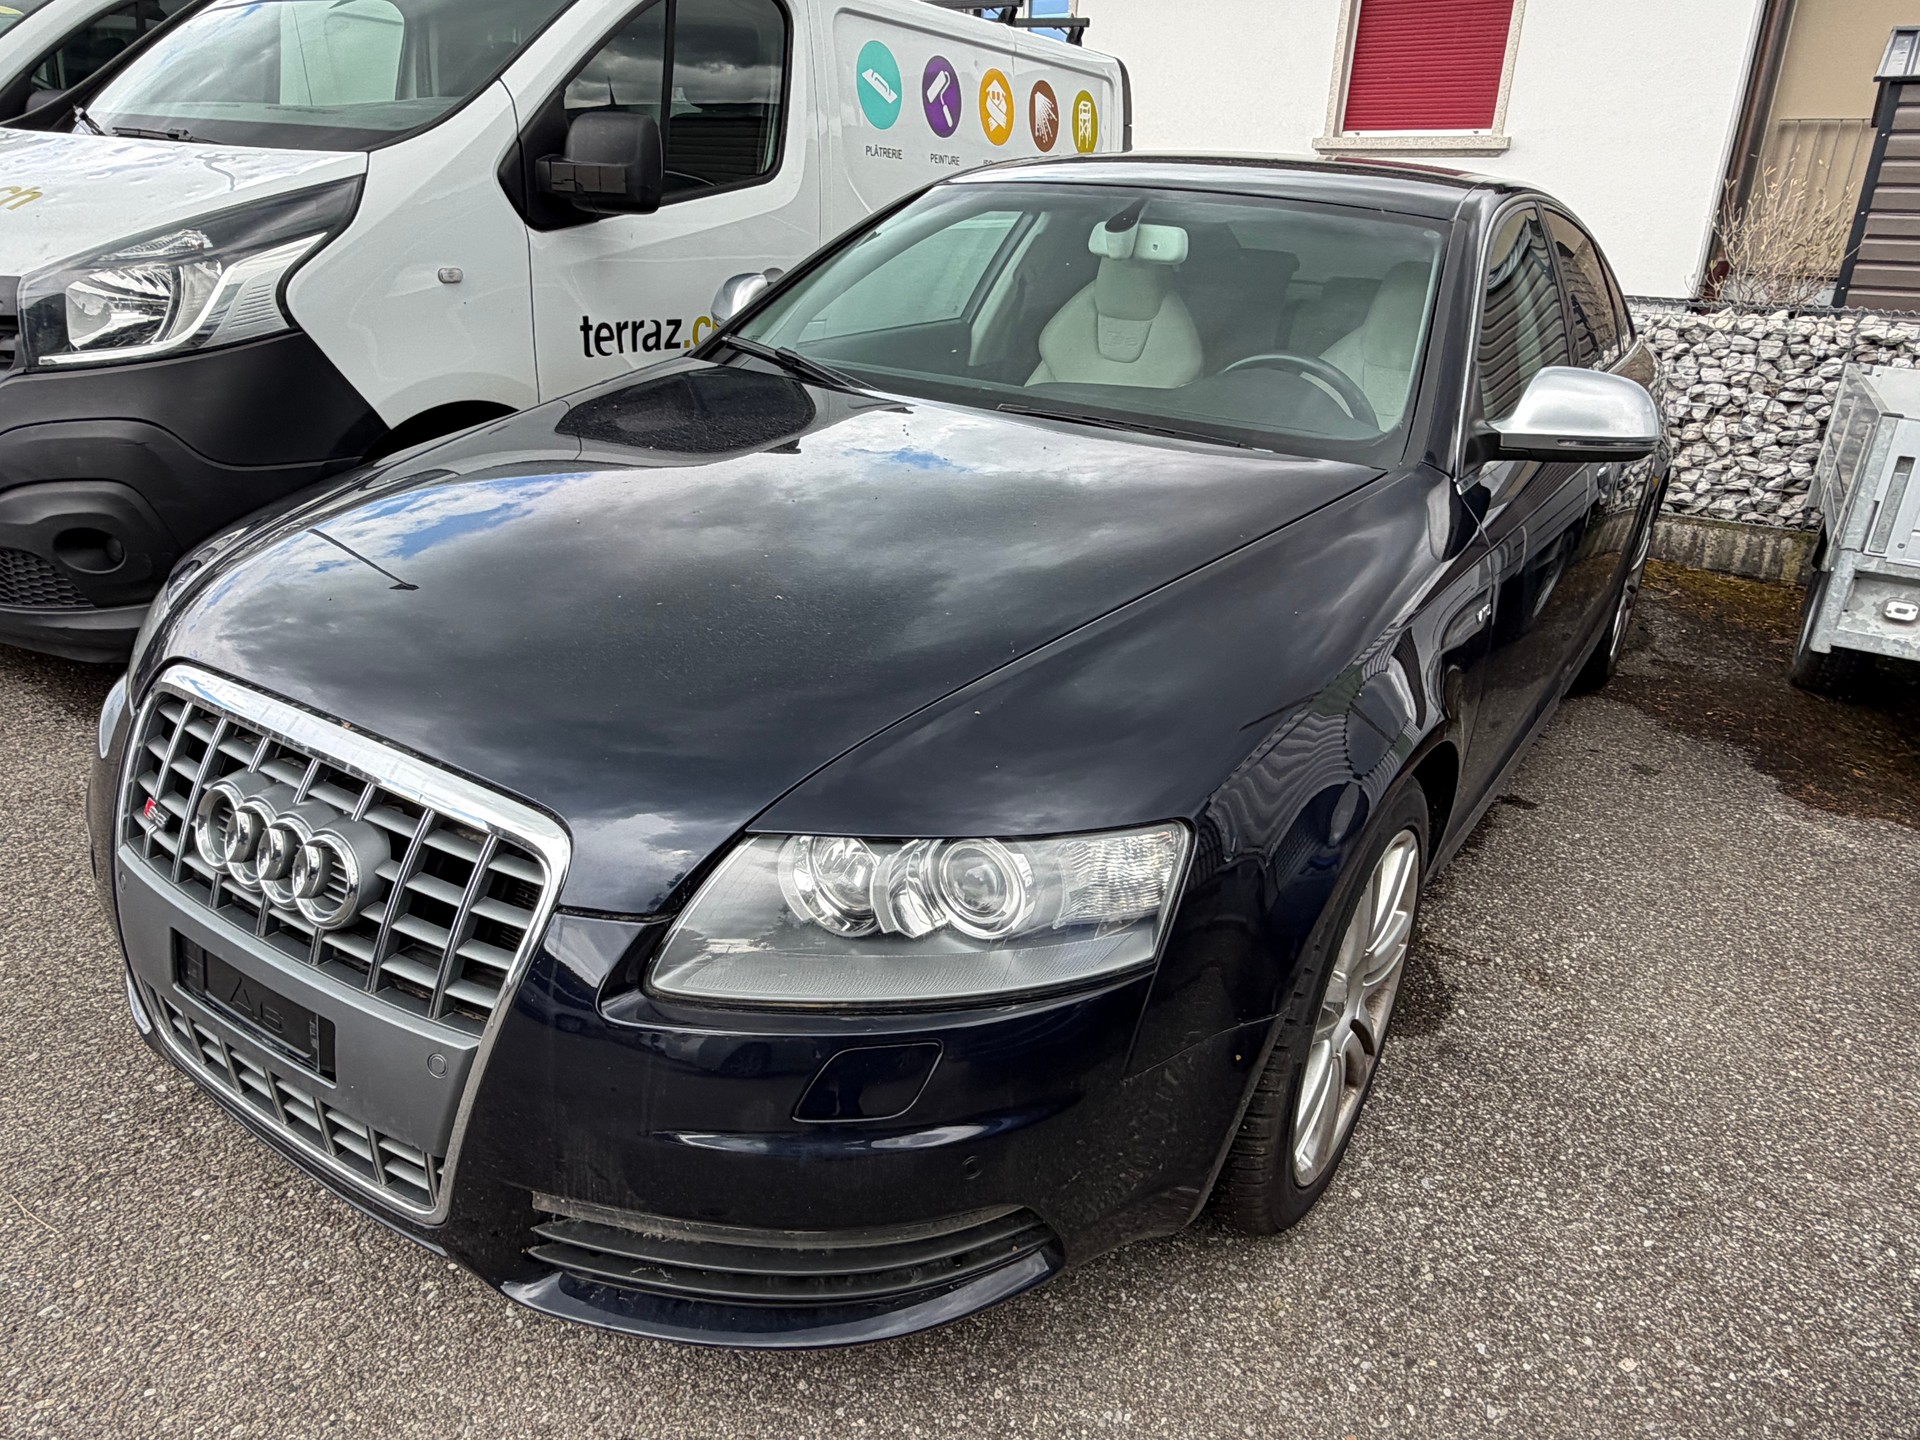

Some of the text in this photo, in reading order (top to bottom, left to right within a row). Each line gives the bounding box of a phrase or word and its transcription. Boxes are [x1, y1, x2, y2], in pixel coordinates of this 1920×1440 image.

[865, 144, 903, 160] PLÂTRERIE
[930, 153, 960, 167] PEINTURE
[580, 315, 720, 358] terraz.c
